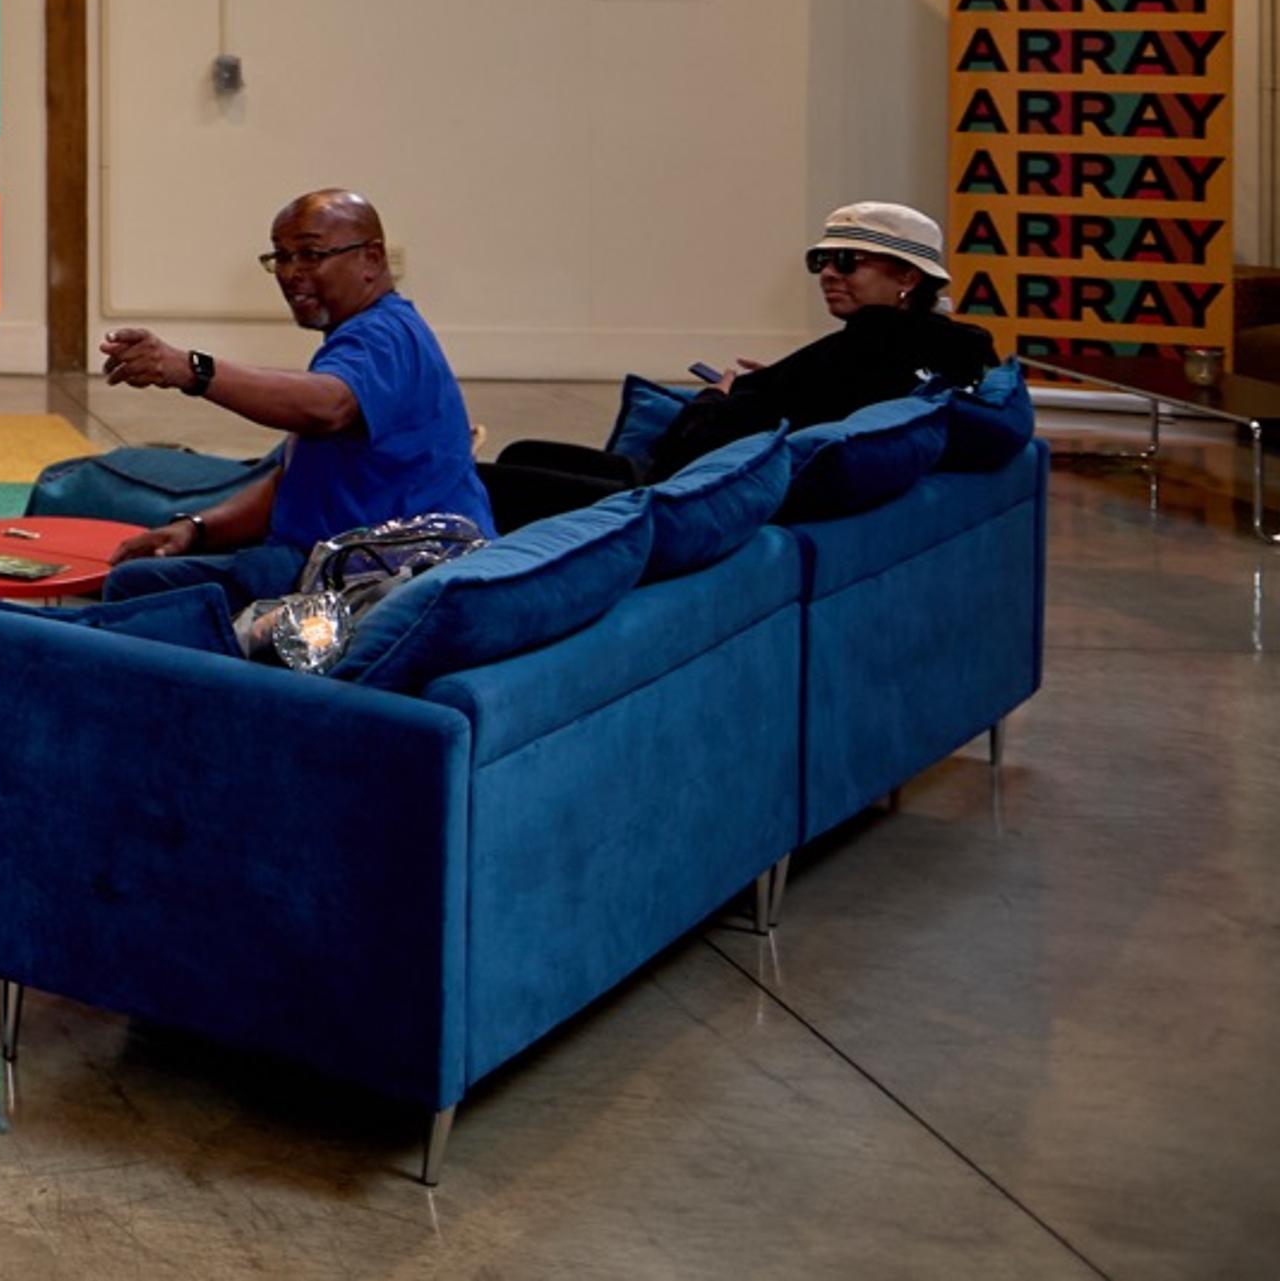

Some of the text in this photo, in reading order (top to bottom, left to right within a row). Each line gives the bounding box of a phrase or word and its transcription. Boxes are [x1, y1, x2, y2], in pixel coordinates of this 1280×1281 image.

[956, 28, 1226, 77] ARRAY
[956, 88, 1226, 139] ARRAY
[956, 150, 1226, 202] ARRAY
[956, 211, 1226, 265] ARRAY
[956, 272, 1225, 328] ARRAY
